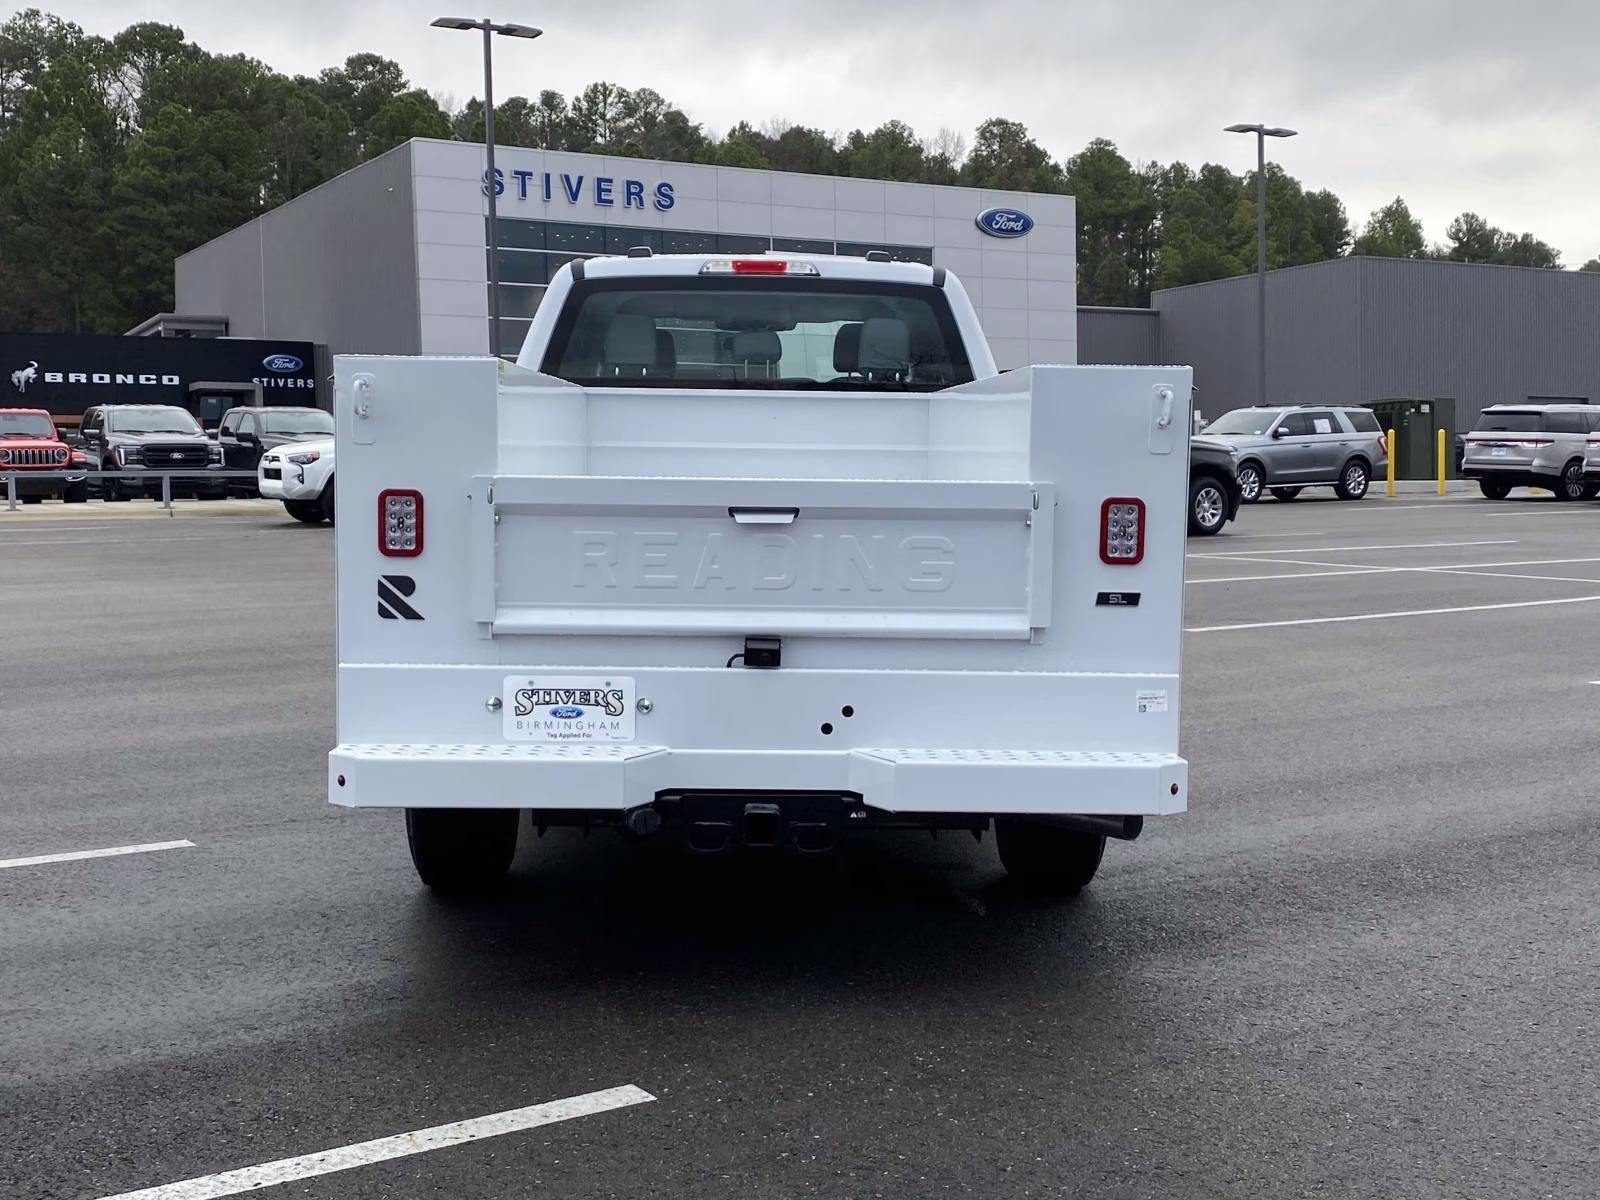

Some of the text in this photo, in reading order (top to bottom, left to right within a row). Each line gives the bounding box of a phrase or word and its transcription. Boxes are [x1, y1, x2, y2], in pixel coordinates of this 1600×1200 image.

[482, 168, 675, 211] STIVERS
[992, 212, 1024, 231] Ford
[272, 358, 296, 369] Ford
[44, 372, 180, 385] BRONCO
[252, 377, 315, 389] STIVERS
[572, 530, 958, 593] READING
[1108, 594, 1128, 604] SL
[514, 688, 625, 717] STIVERS
[516, 721, 621, 731] BIRMINGHAM
[546, 732, 558, 740] Tag
[558, 732, 581, 740] Applied
